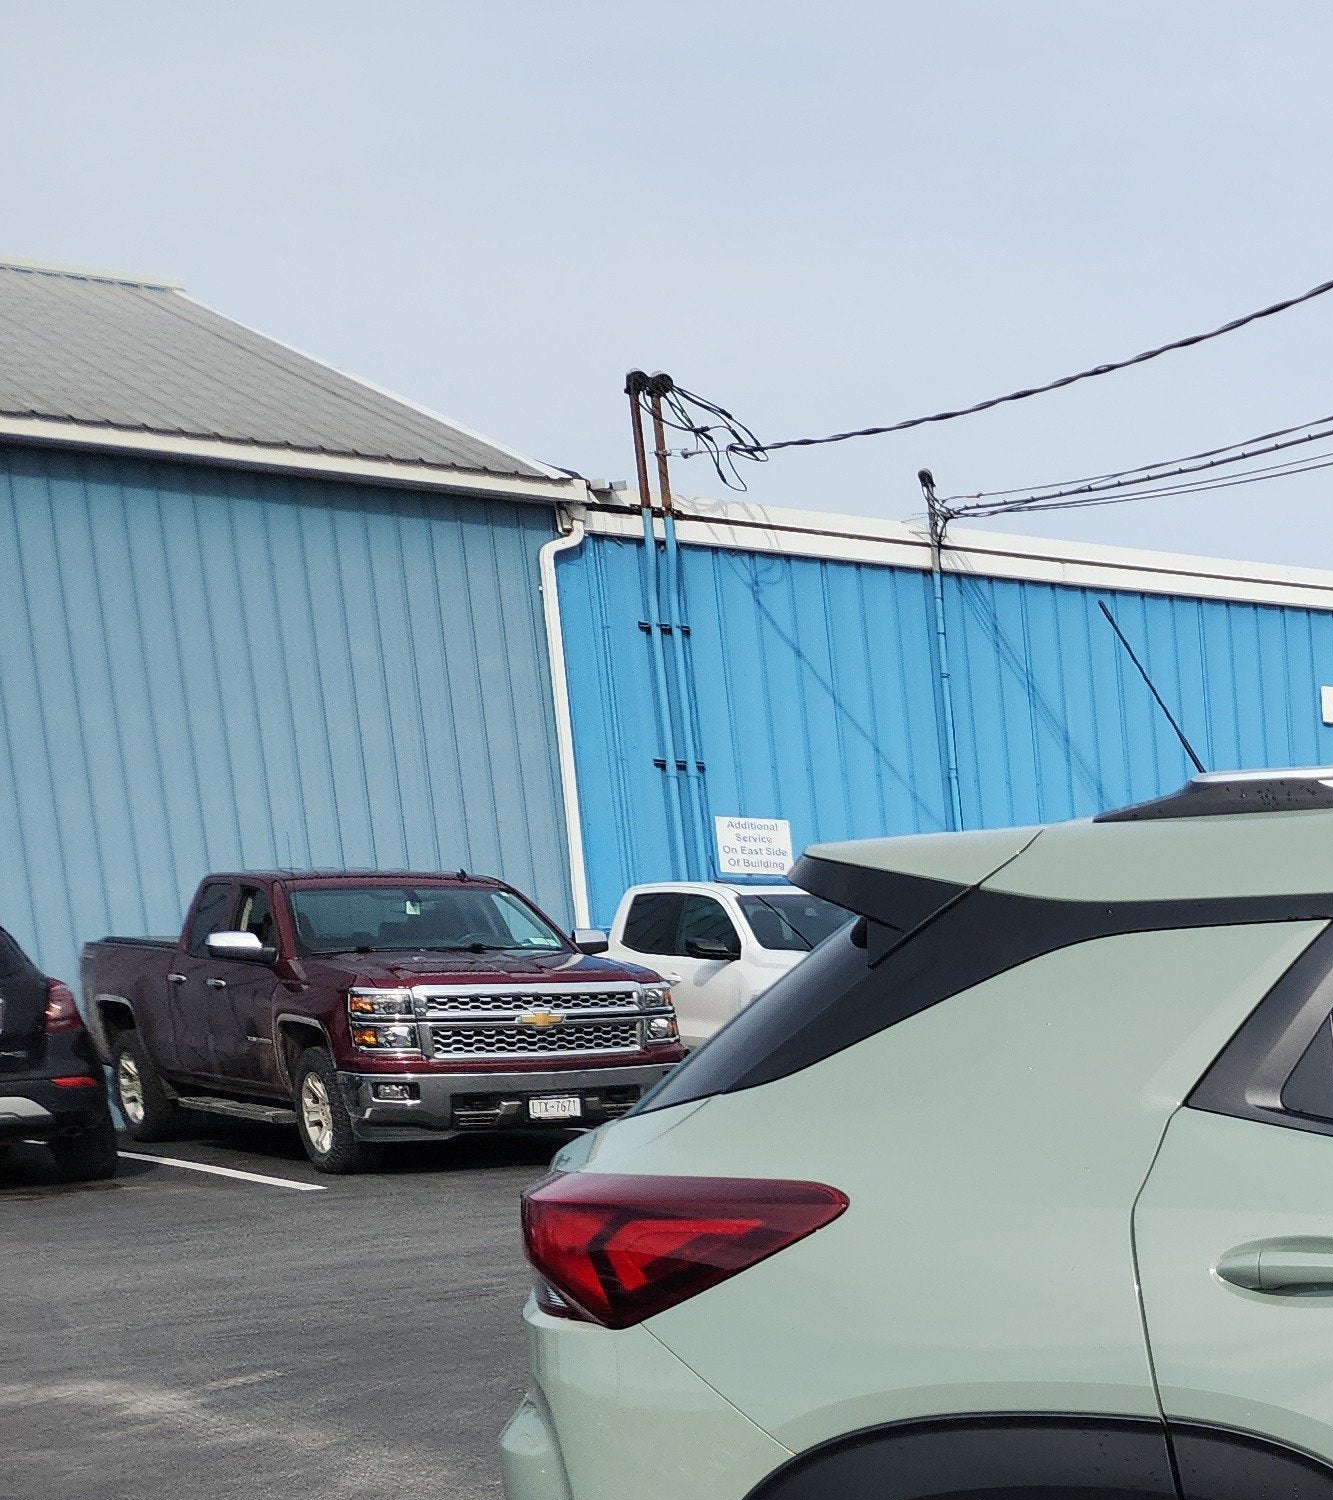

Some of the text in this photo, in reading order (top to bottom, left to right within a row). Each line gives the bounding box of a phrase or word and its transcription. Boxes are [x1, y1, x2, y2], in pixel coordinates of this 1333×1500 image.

[726, 820, 779, 831] Additional
[734, 833, 773, 843] Service
[722, 845, 787, 857] On East Side
[728, 858, 785, 870] Of Building
